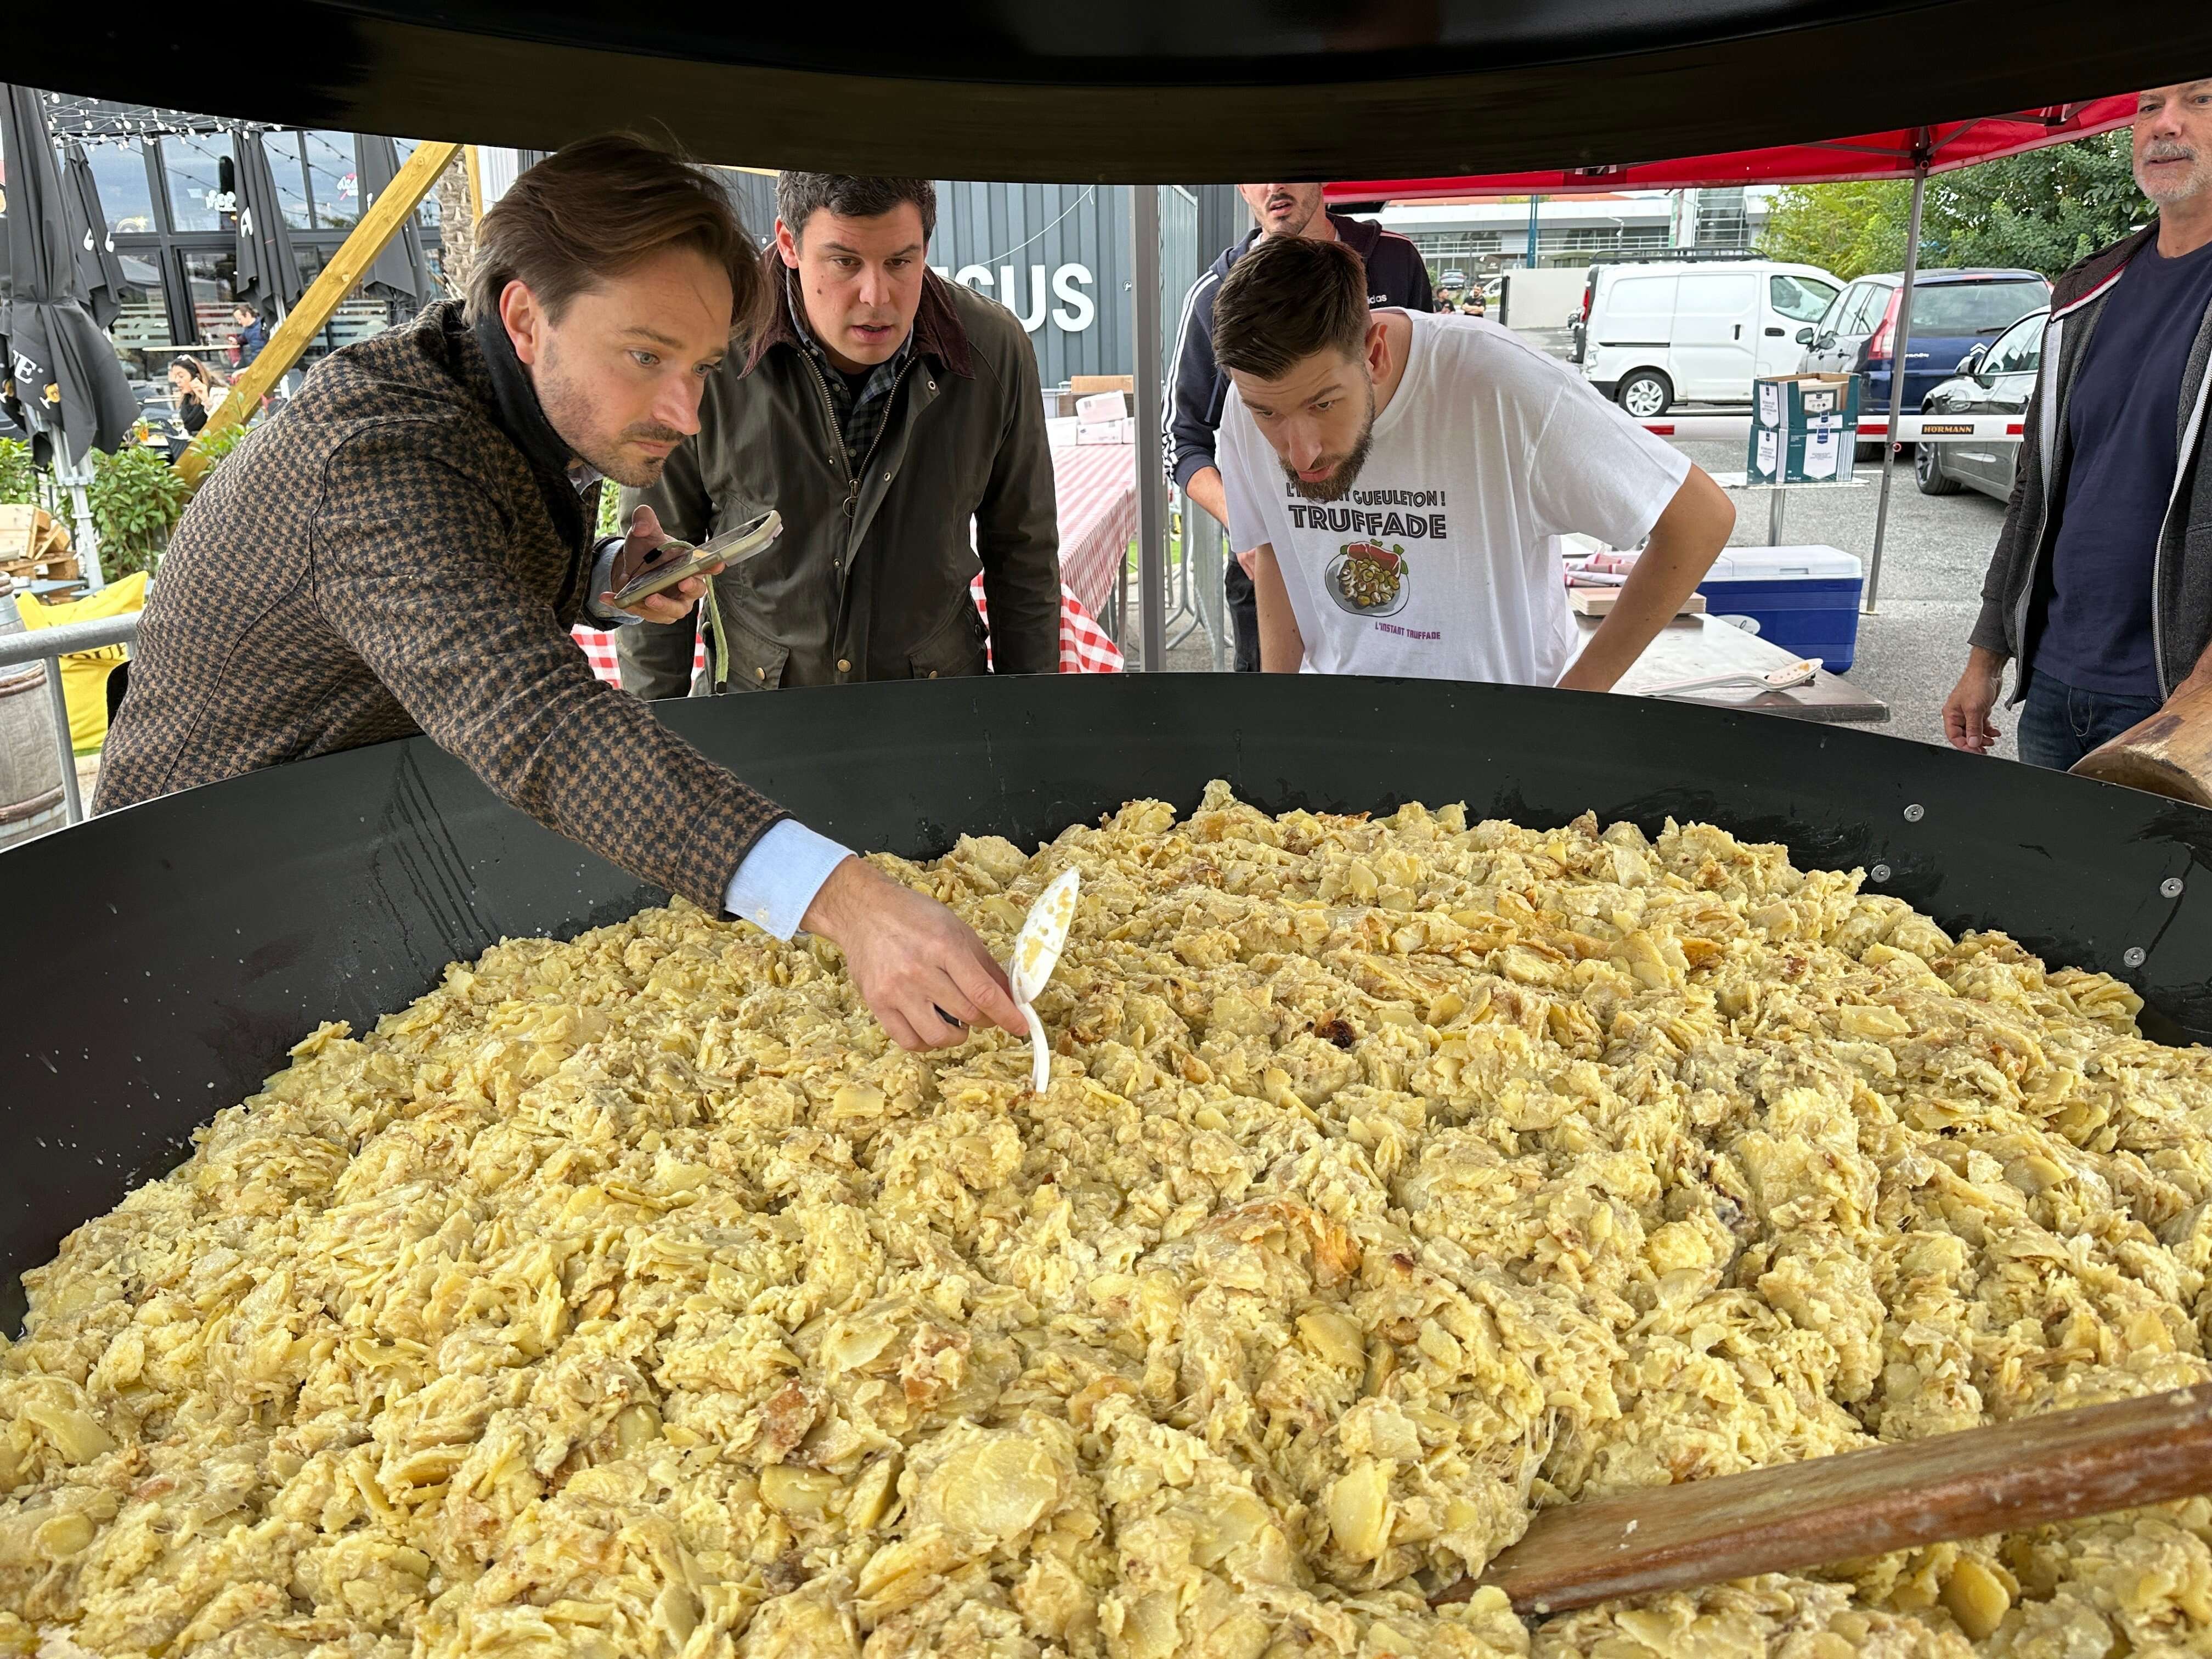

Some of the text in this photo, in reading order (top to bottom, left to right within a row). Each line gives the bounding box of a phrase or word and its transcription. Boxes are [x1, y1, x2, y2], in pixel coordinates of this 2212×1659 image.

[1353, 489, 1437, 507] GUEULETON
[1288, 505, 1447, 539] TRUFFADE
[1375, 622, 1441, 640] L'INSTANT TRUFFADE
